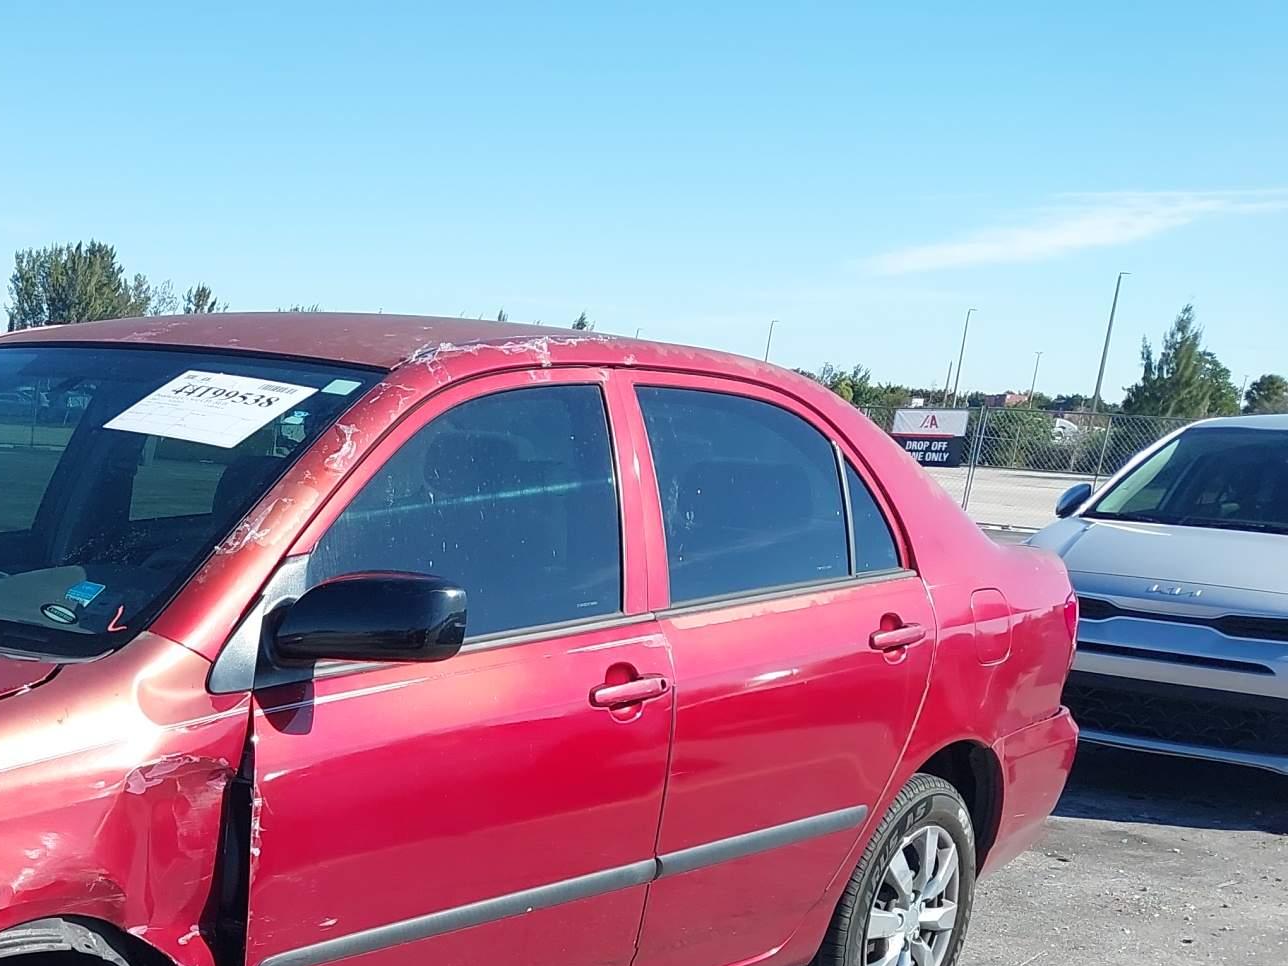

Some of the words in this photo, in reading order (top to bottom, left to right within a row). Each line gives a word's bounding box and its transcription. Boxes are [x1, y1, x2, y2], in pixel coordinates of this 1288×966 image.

[905, 440, 930, 451] DROP
[931, 441, 948, 451] OFF
[925, 452, 950, 462] ONLY
